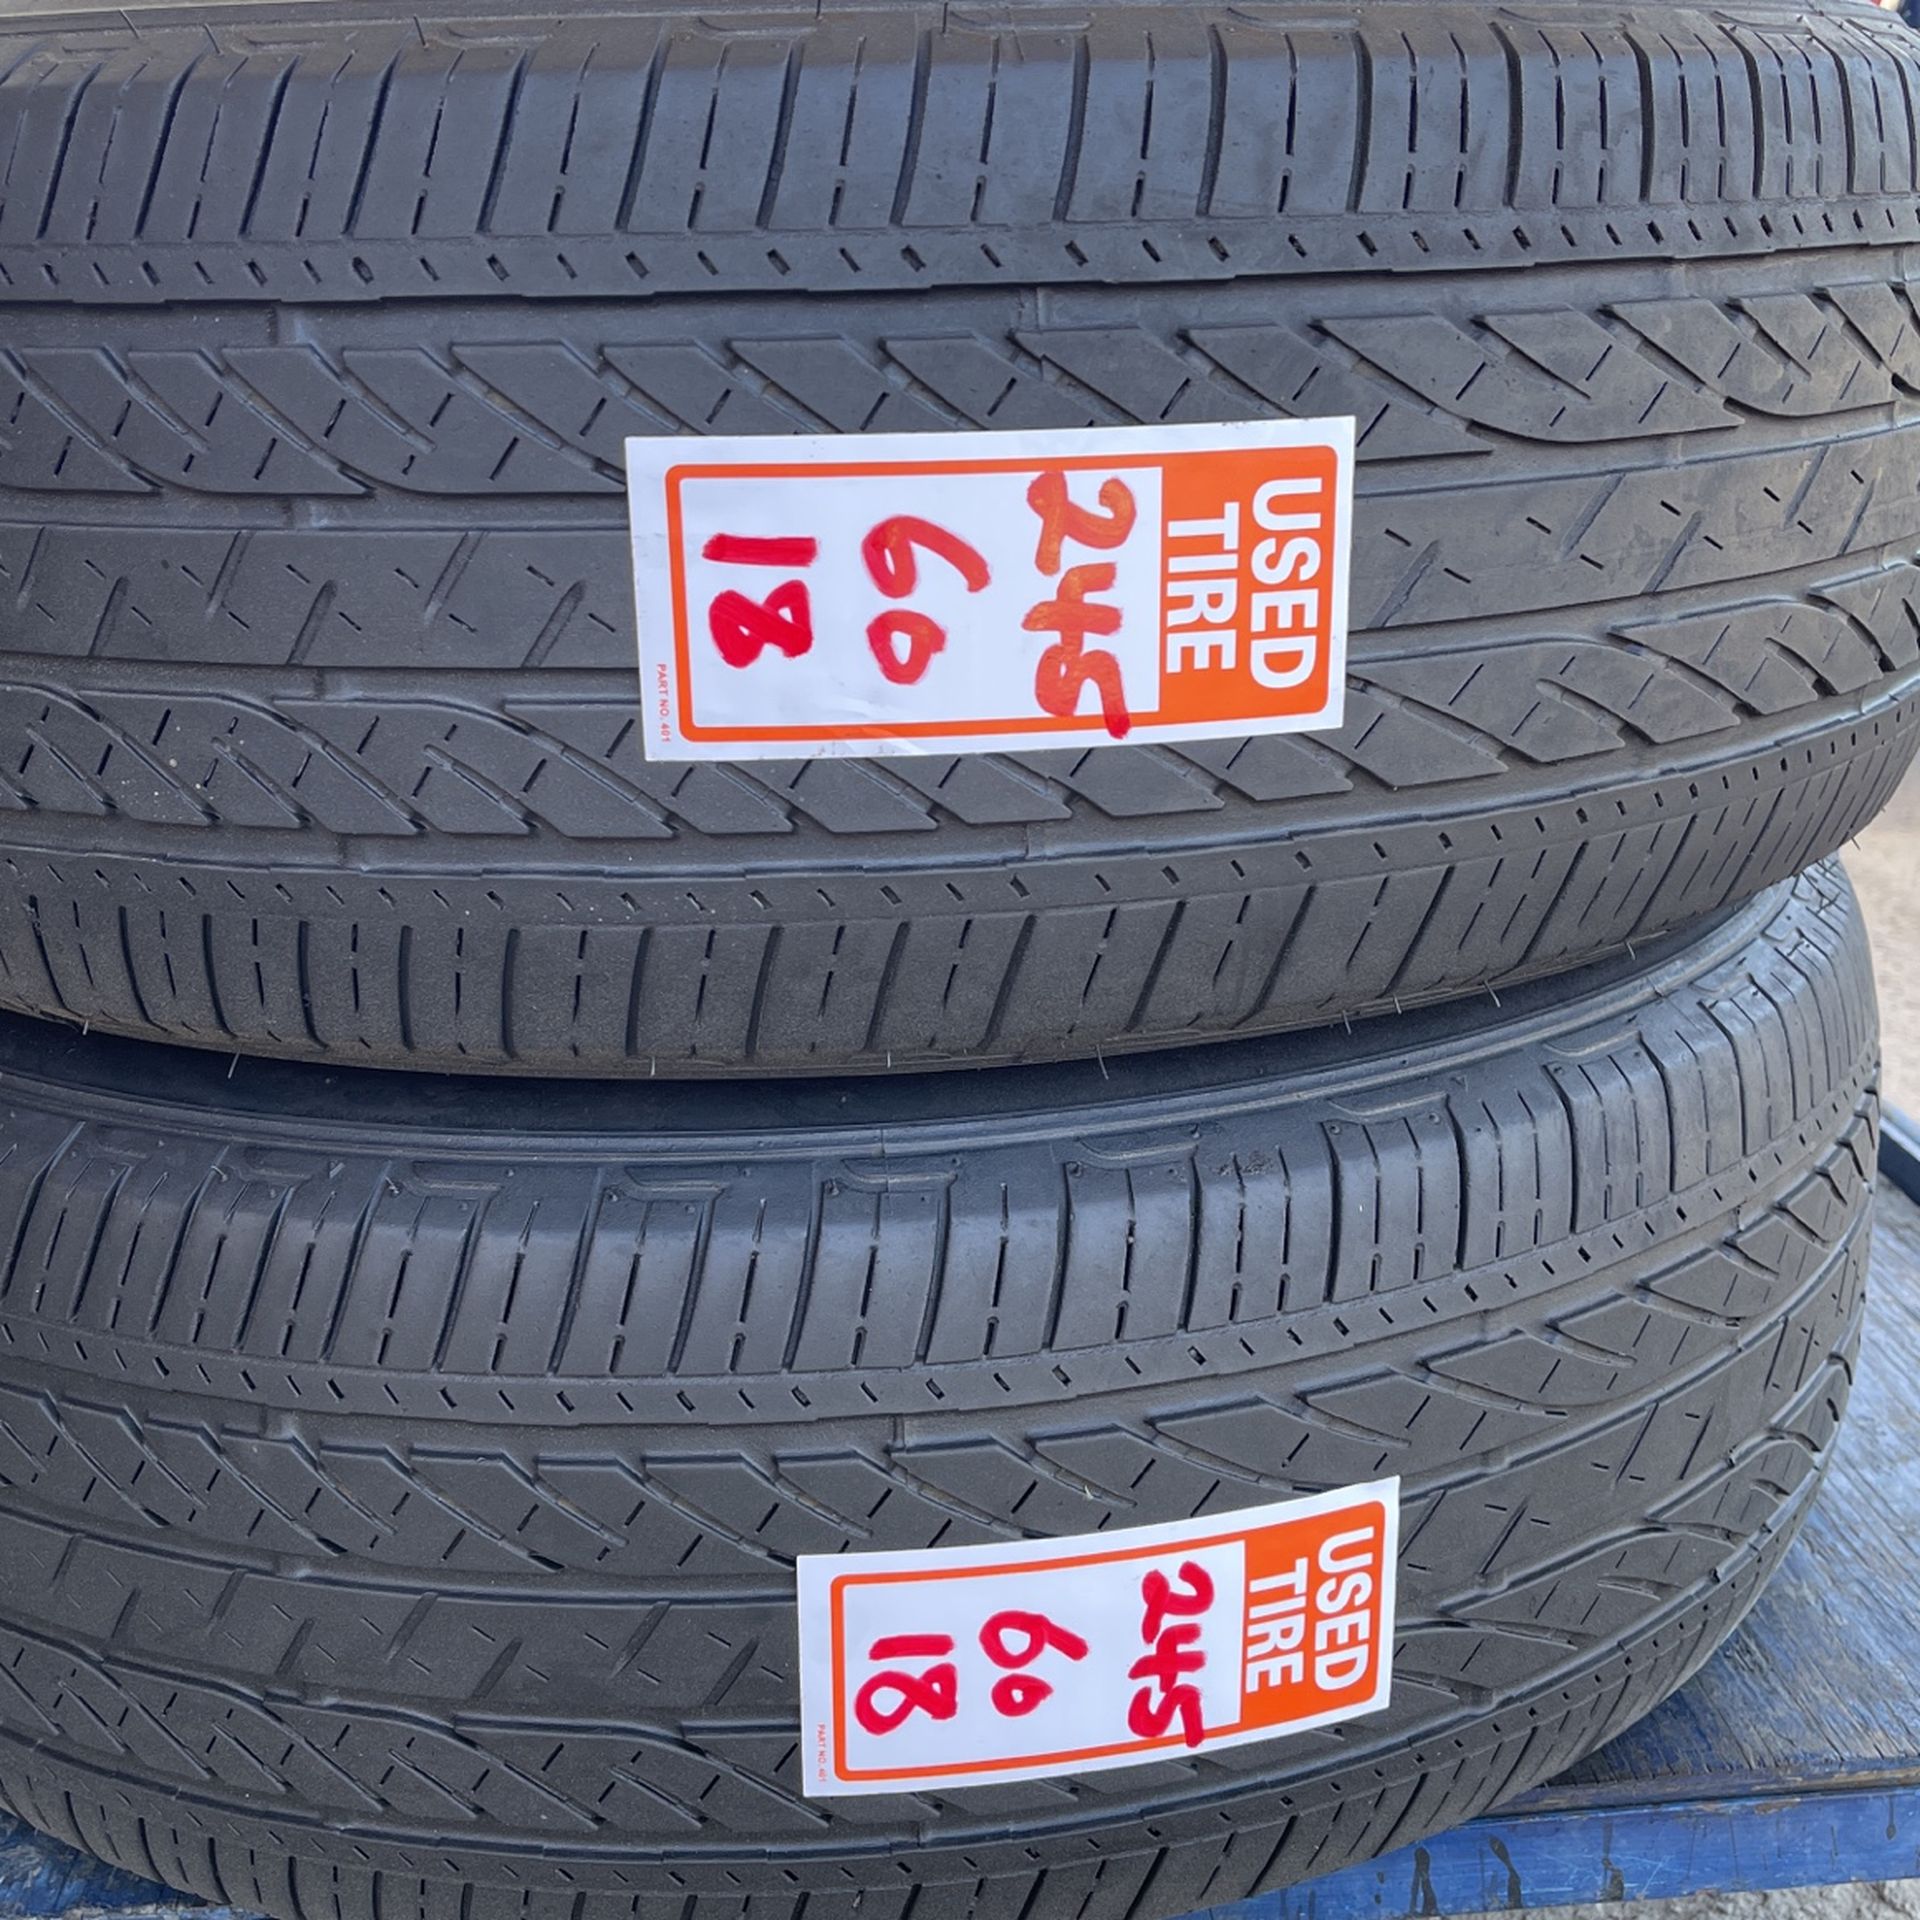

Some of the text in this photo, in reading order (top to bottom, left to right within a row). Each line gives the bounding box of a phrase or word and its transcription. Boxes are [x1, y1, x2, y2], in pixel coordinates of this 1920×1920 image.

[702, 533, 818, 668] 18
[861, 515, 991, 685] 60
[1022, 471, 1137, 740] 245
[1166, 502, 1240, 674] TIRE
[1251, 477, 1322, 689] USED
[657, 663, 671, 743] PART NO. 401
[979, 1610, 1089, 1718] 60
[1128, 1561, 1214, 1748] 245
[1246, 1557, 1308, 1693] TIRE
[1313, 1526, 1375, 1691] USED
[817, 1723, 826, 1748] PART
[855, 1634, 958, 1735] 18
